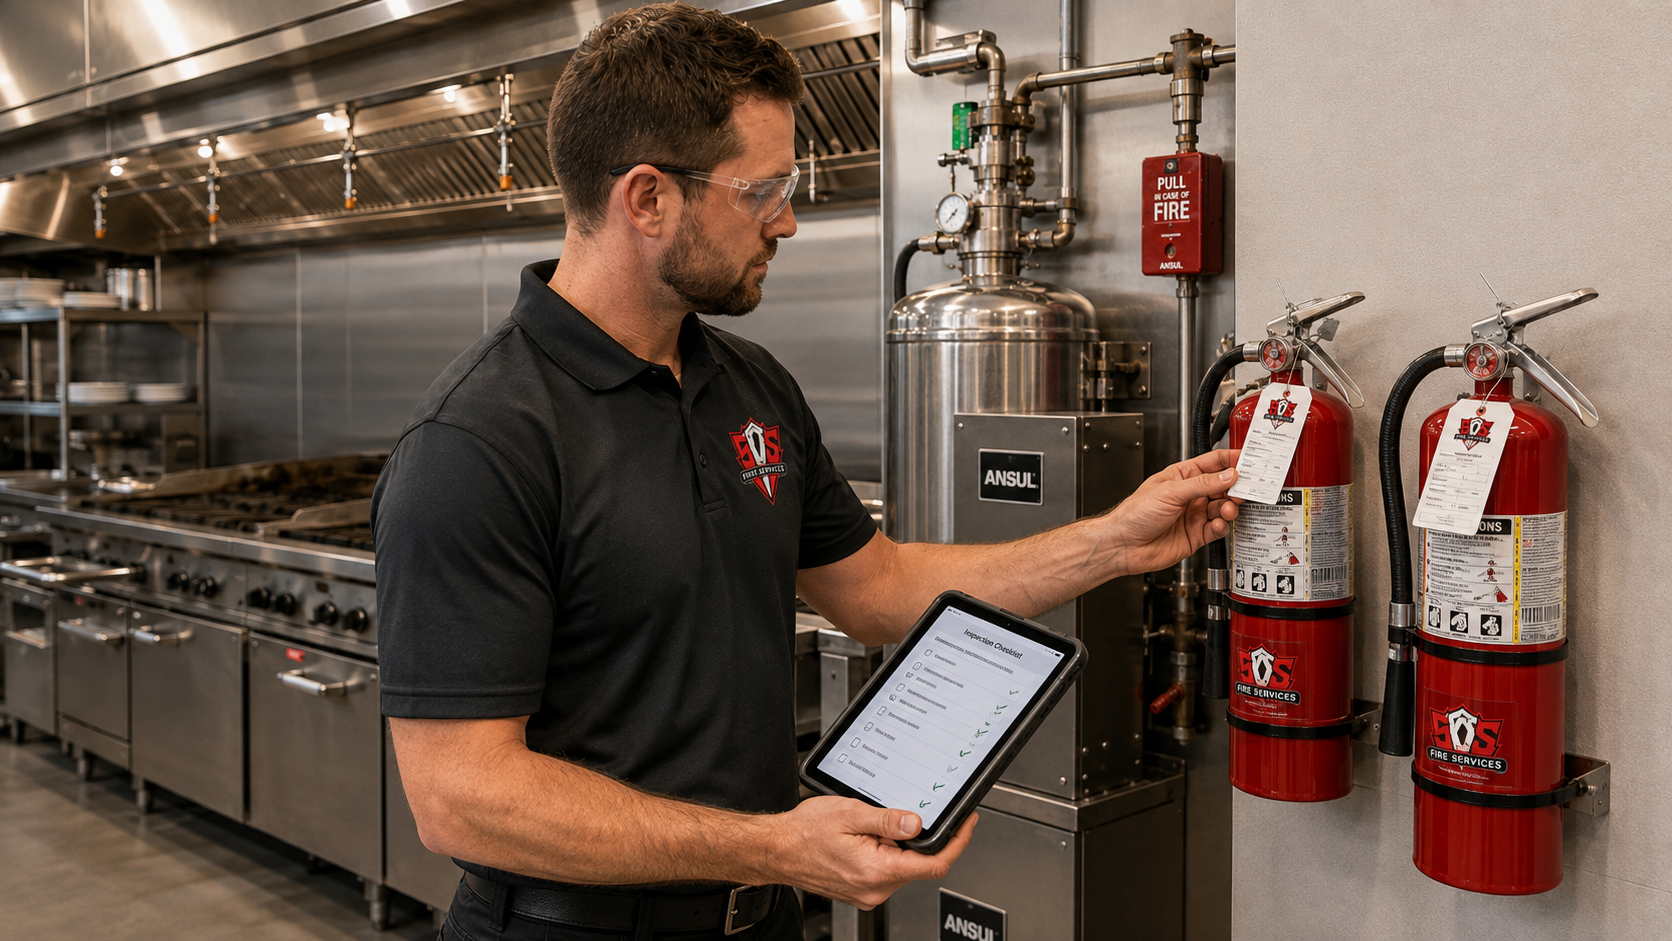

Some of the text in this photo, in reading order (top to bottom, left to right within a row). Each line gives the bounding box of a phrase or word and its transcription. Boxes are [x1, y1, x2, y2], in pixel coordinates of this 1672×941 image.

[1157, 175, 1187, 191] PULL
[1162, 191, 1179, 200] CASE
[1181, 190, 1190, 199] OF
[1154, 200, 1190, 221] FIRE
[1159, 261, 1184, 270] ANSUL
[984, 469, 1038, 489] ANSUL
[963, 628, 995, 648] Inspection
[1253, 687, 1296, 702] SERVICES
[1430, 749, 1502, 770] FIRE SERVICES
